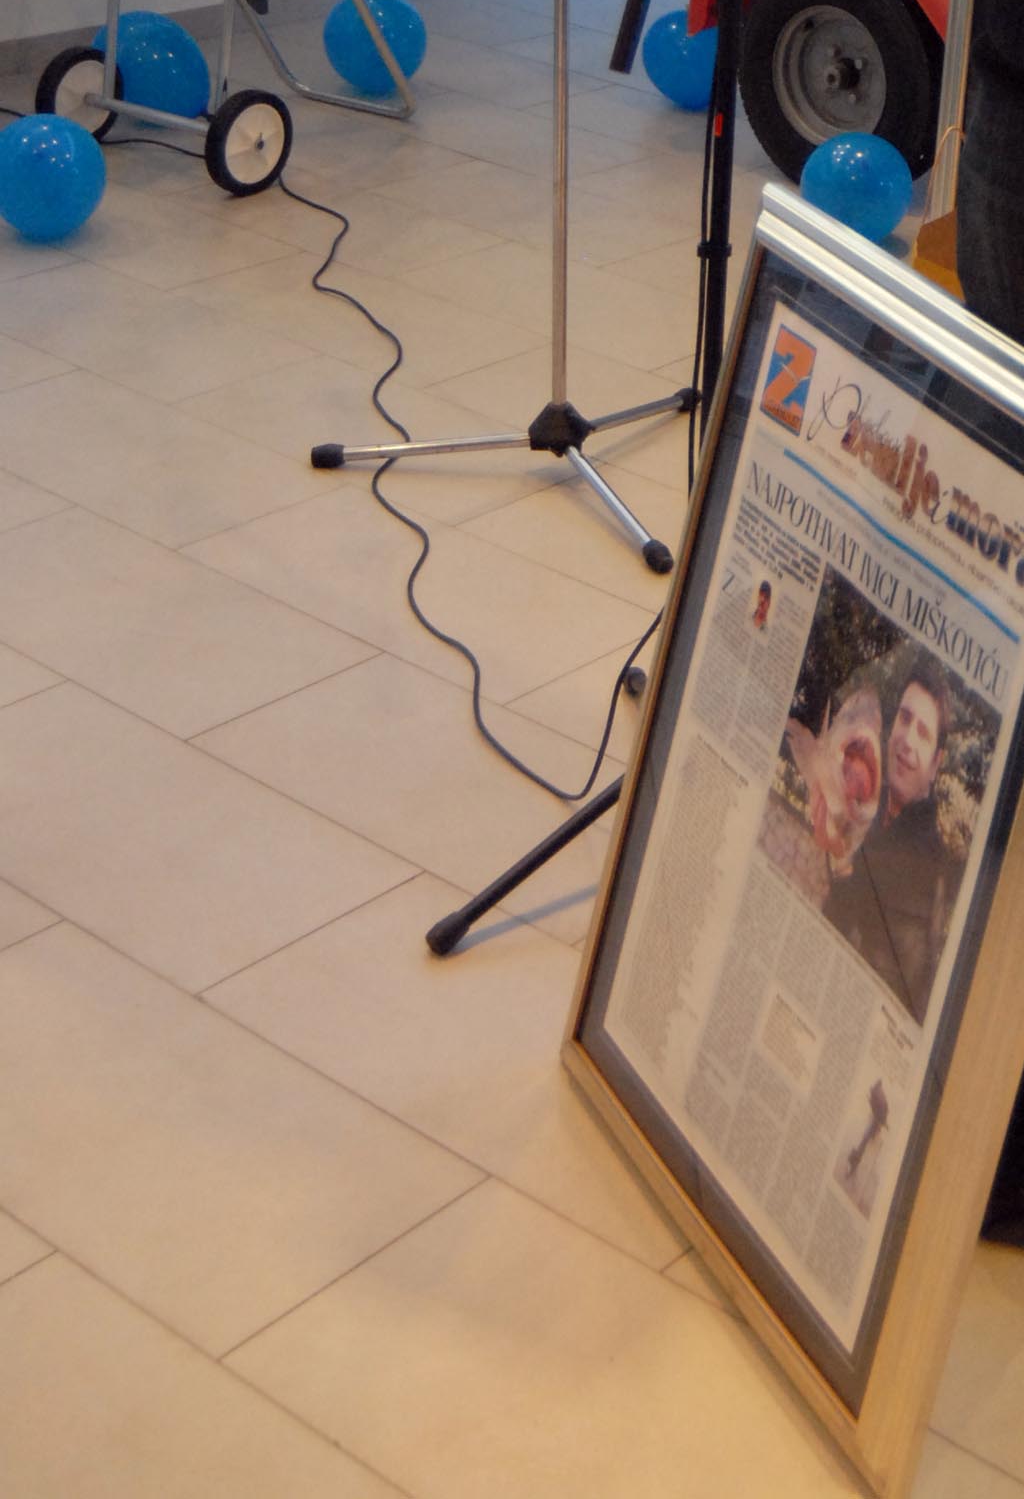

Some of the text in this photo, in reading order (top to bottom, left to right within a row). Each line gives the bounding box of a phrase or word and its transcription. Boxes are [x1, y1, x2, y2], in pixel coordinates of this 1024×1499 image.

[747, 461, 861, 570] NAJPOTHVAT
[860, 540, 901, 611] IVICI
[902, 582, 1011, 702] MIŠKOVIĆU
